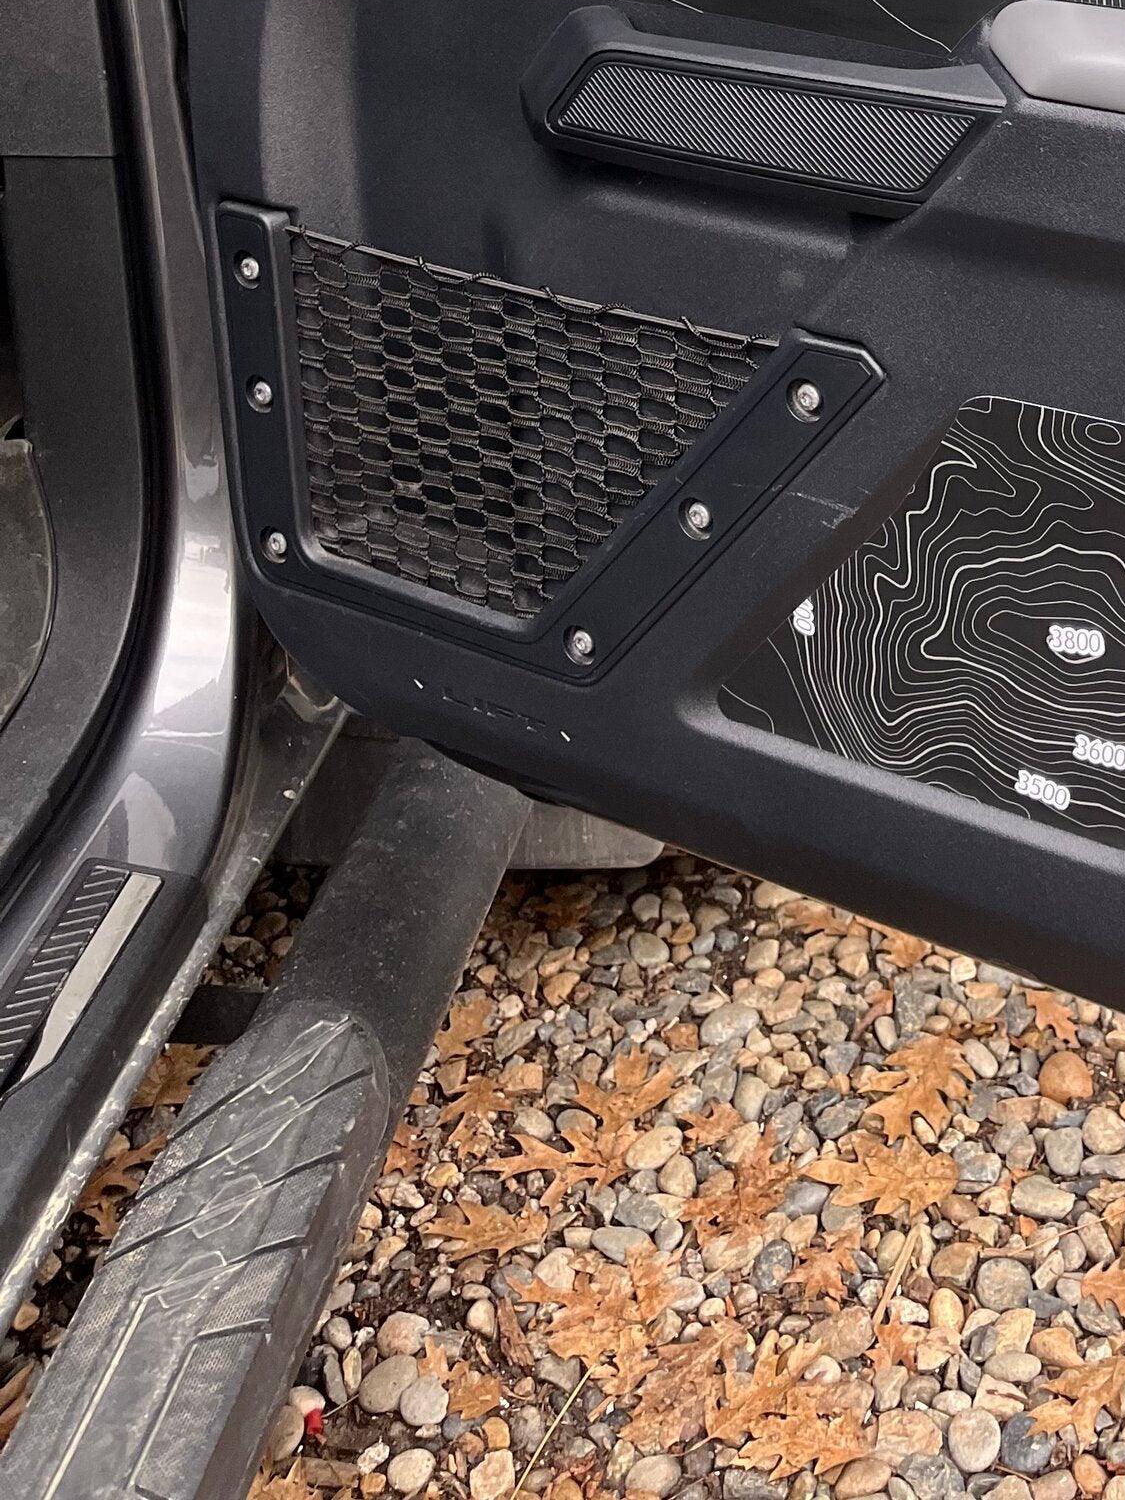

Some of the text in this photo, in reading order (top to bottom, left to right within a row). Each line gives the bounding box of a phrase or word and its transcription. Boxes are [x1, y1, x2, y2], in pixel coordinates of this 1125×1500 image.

[793, 598, 815, 637] 00
[1049, 625, 1105, 654] 3800
[1014, 770, 1071, 810] 3500
